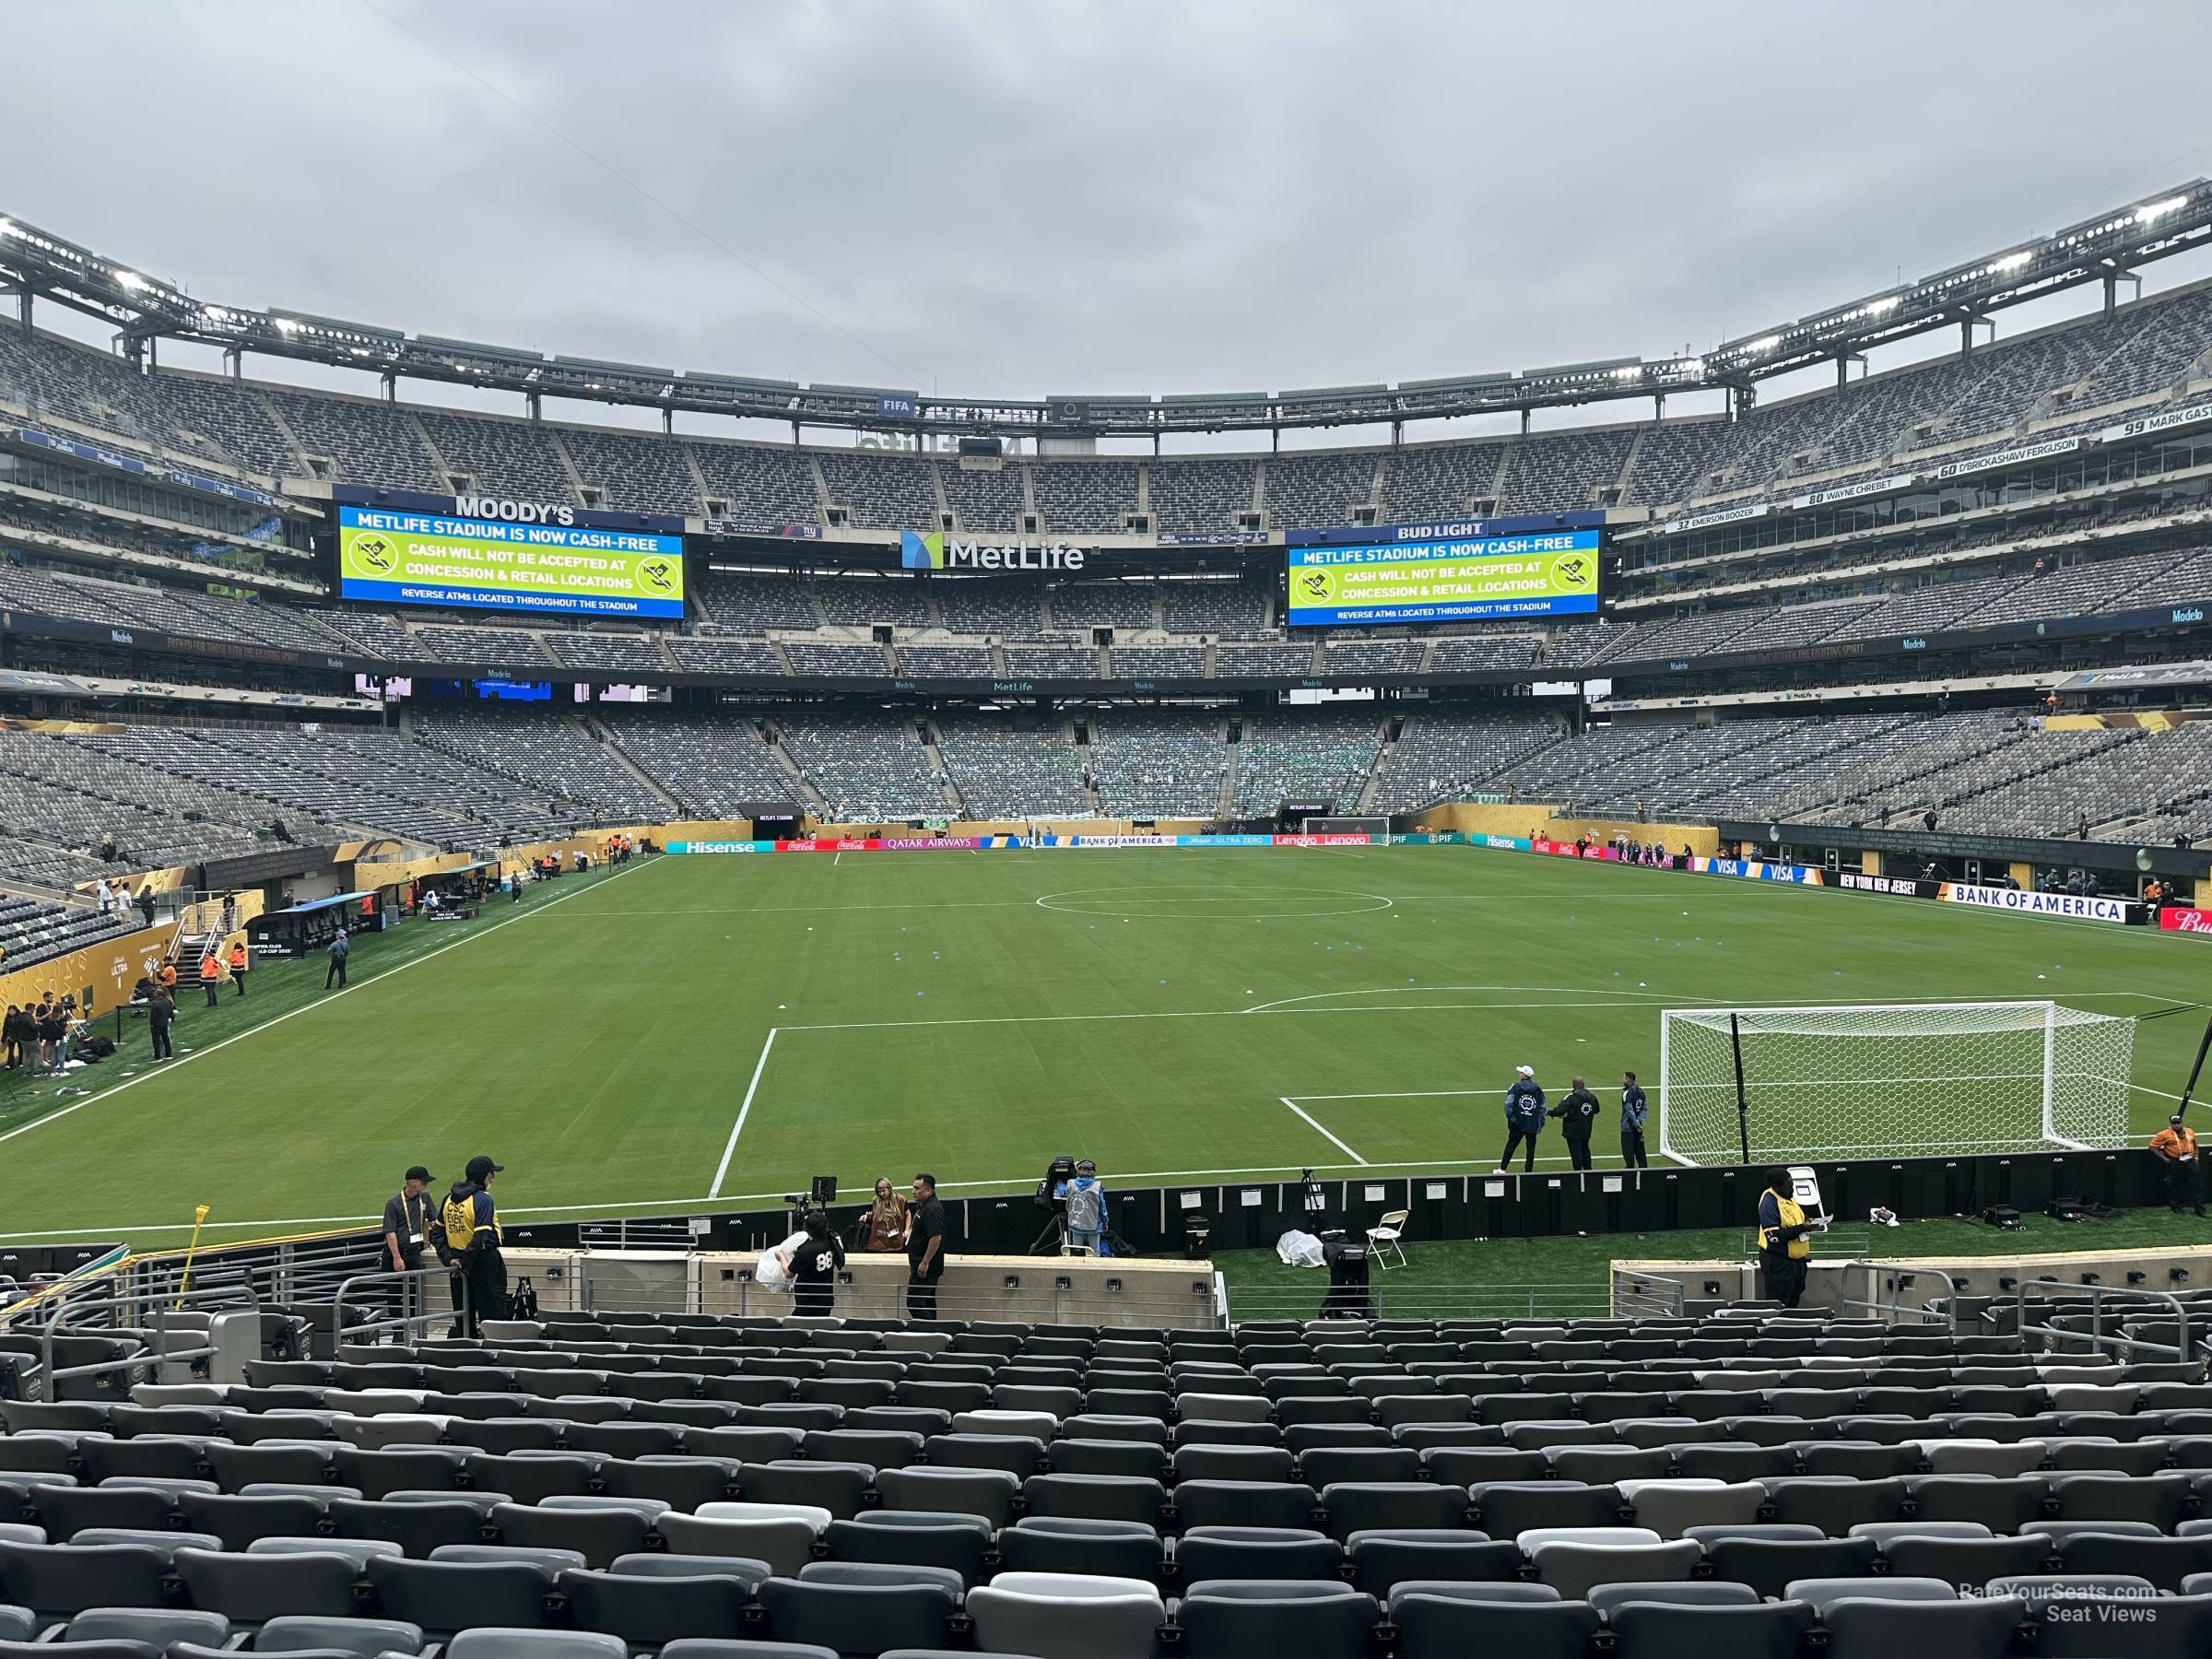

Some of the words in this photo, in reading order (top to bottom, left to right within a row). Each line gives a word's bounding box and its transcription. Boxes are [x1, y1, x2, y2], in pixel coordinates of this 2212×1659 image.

[884, 400, 910, 414] FIFA
[2124, 420, 2145, 436] 99
[2148, 413, 2184, 429] MARK
[1940, 465, 1957, 477] 60
[2027, 439, 2077, 457] FERGUSON
[1808, 493, 1824, 505] 80
[1826, 487, 1855, 500] WAYNE
[1855, 479, 1893, 494] CHREBET
[455, 497, 574, 525] MOODY'S
[1677, 521, 1689, 531] 32
[1692, 513, 1724, 527] EMERSON
[1724, 508, 1754, 522] BOOZER
[358, 512, 430, 533] METLIFE
[433, 521, 506, 540] STADIUM
[510, 527, 525, 541] IS
[529, 529, 566, 545] NOW
[569, 533, 658, 552] CASH-FREE
[1397, 526, 1434, 539] BUD
[1436, 524, 1483, 537] LIGHT
[407, 544, 447, 559] CASH
[448, 546, 484, 561] WILL
[487, 547, 514, 563] NOT
[517, 552, 535, 565] BE
[538, 555, 607, 571] ACCEPTED
[609, 559, 627, 571] AT
[949, 539, 1084, 570] MetLife
[1303, 549, 1363, 564] METLIFE
[1366, 547, 1430, 561] STADIUM
[1432, 546, 1446, 558] IS
[1450, 543, 1485, 557] NOW
[1488, 536, 1574, 554] CASH-FREE
[405, 562, 495, 582] CONCESSION
[497, 570, 508, 582] &
[511, 571, 558, 585] RETAIL
[559, 573, 634, 590] LOCATIONS
[1344, 571, 1378, 582] CASH
[1378, 571, 1409, 582] WILL
[1411, 569, 1437, 580] NOT
[1439, 567, 1456, 578] BE
[1458, 563, 1523, 577] ACCEPTED
[1524, 561, 1542, 572] AT
[1341, 586, 1418, 600] CONCESSION
[1420, 585, 1430, 596] &
[1432, 585, 1476, 594] RETAIL
[1477, 579, 1547, 594] LOCATIONS
[401, 588, 445, 600] REVERSE
[445, 591, 472, 601] ATMs
[473, 592, 514, 605] LOCATED
[515, 596, 578, 608] THROUGHOUT
[579, 599, 597, 609] THE
[598, 601, 638, 612] STADIUM
[1337, 610, 1374, 620] REVERSE
[1374, 610, 1397, 618] ATMs
[1397, 608, 1435, 618] LOCATED
[1436, 605, 1492, 617] THROUGHOUT
[1494, 604, 1512, 612] THE
[1512, 602, 1551, 612] STADIUM
[2172, 608, 2204, 622] Modelo
[112, 629, 133, 644] Modelo
[1841, 643, 1865, 655] SPIRIT
[1902, 639, 1926, 651] Modelo
[488, 669, 512, 678] Modelo
[1670, 661, 1688, 672] Modelo
[994, 682, 1033, 691] MetLife
[888, 839, 923, 850] QATAR
[927, 838, 971, 849] AIRWAYS
[1277, 834, 1318, 845] Lenovo
[1324, 834, 1366, 845] Lenovo
[1392, 835, 1407, 843] PIF
[1438, 834, 1453, 842] PIF
[1487, 834, 1516, 849] Hisense
[687, 841, 756, 854] Hisense
[1715, 859, 1738, 876] VISA
[1771, 865, 1794, 882] VISA
[1840, 874, 1854, 888] NEW
[1855, 876, 1874, 890] YORK
[1874, 877, 1890, 892] NEW
[1890, 879, 1917, 896] JERSEY
[1956, 887, 2001, 907] BANK
[2006, 892, 2028, 909] OF
[2032, 896, 2120, 921] AMERICA
[447, 1203, 465, 1215] CSC
[447, 1213, 465, 1225] EVENT
[448, 1224, 466, 1235] STAFF
